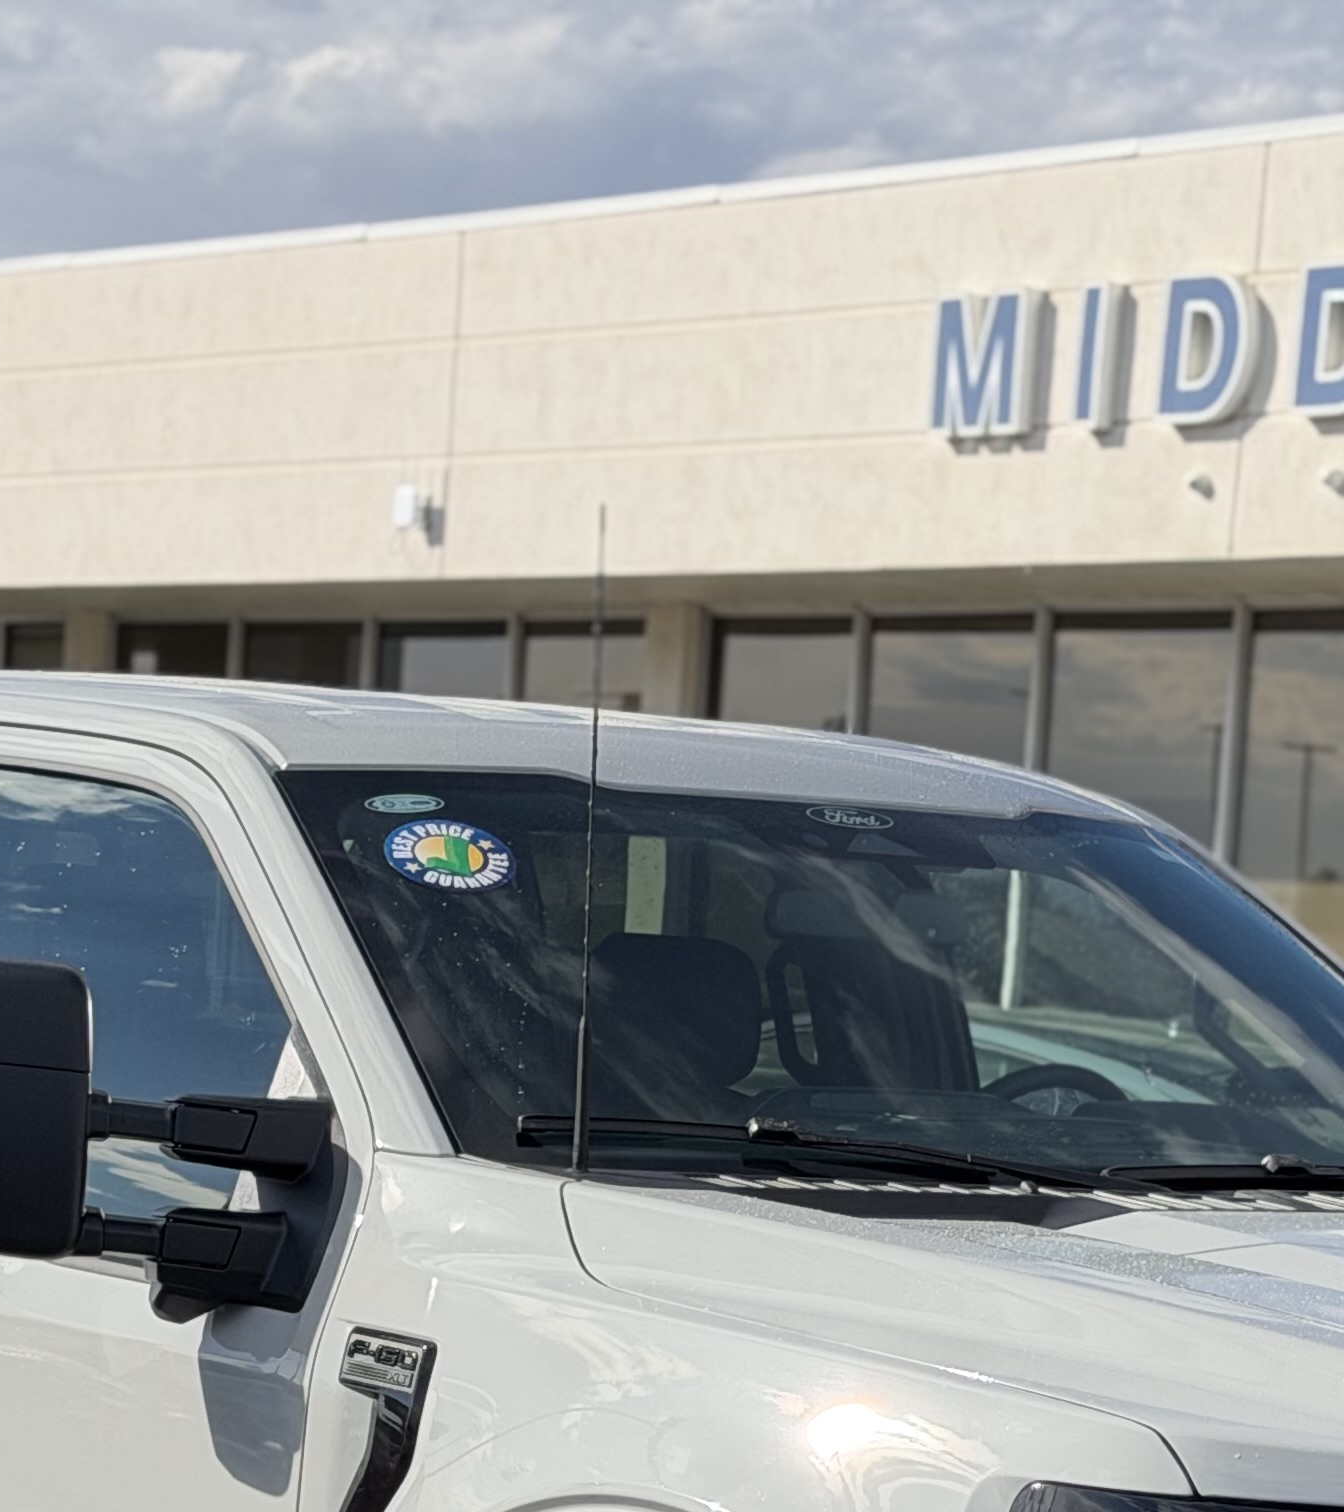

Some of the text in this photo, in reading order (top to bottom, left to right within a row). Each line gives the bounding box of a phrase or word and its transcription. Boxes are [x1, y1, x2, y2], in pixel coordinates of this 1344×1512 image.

[824, 808, 881, 827] Ford
[392, 823, 475, 859] BEST PRICE
[423, 852, 512, 889] GUARANTEE
[387, 1371, 410, 1386] XLT
